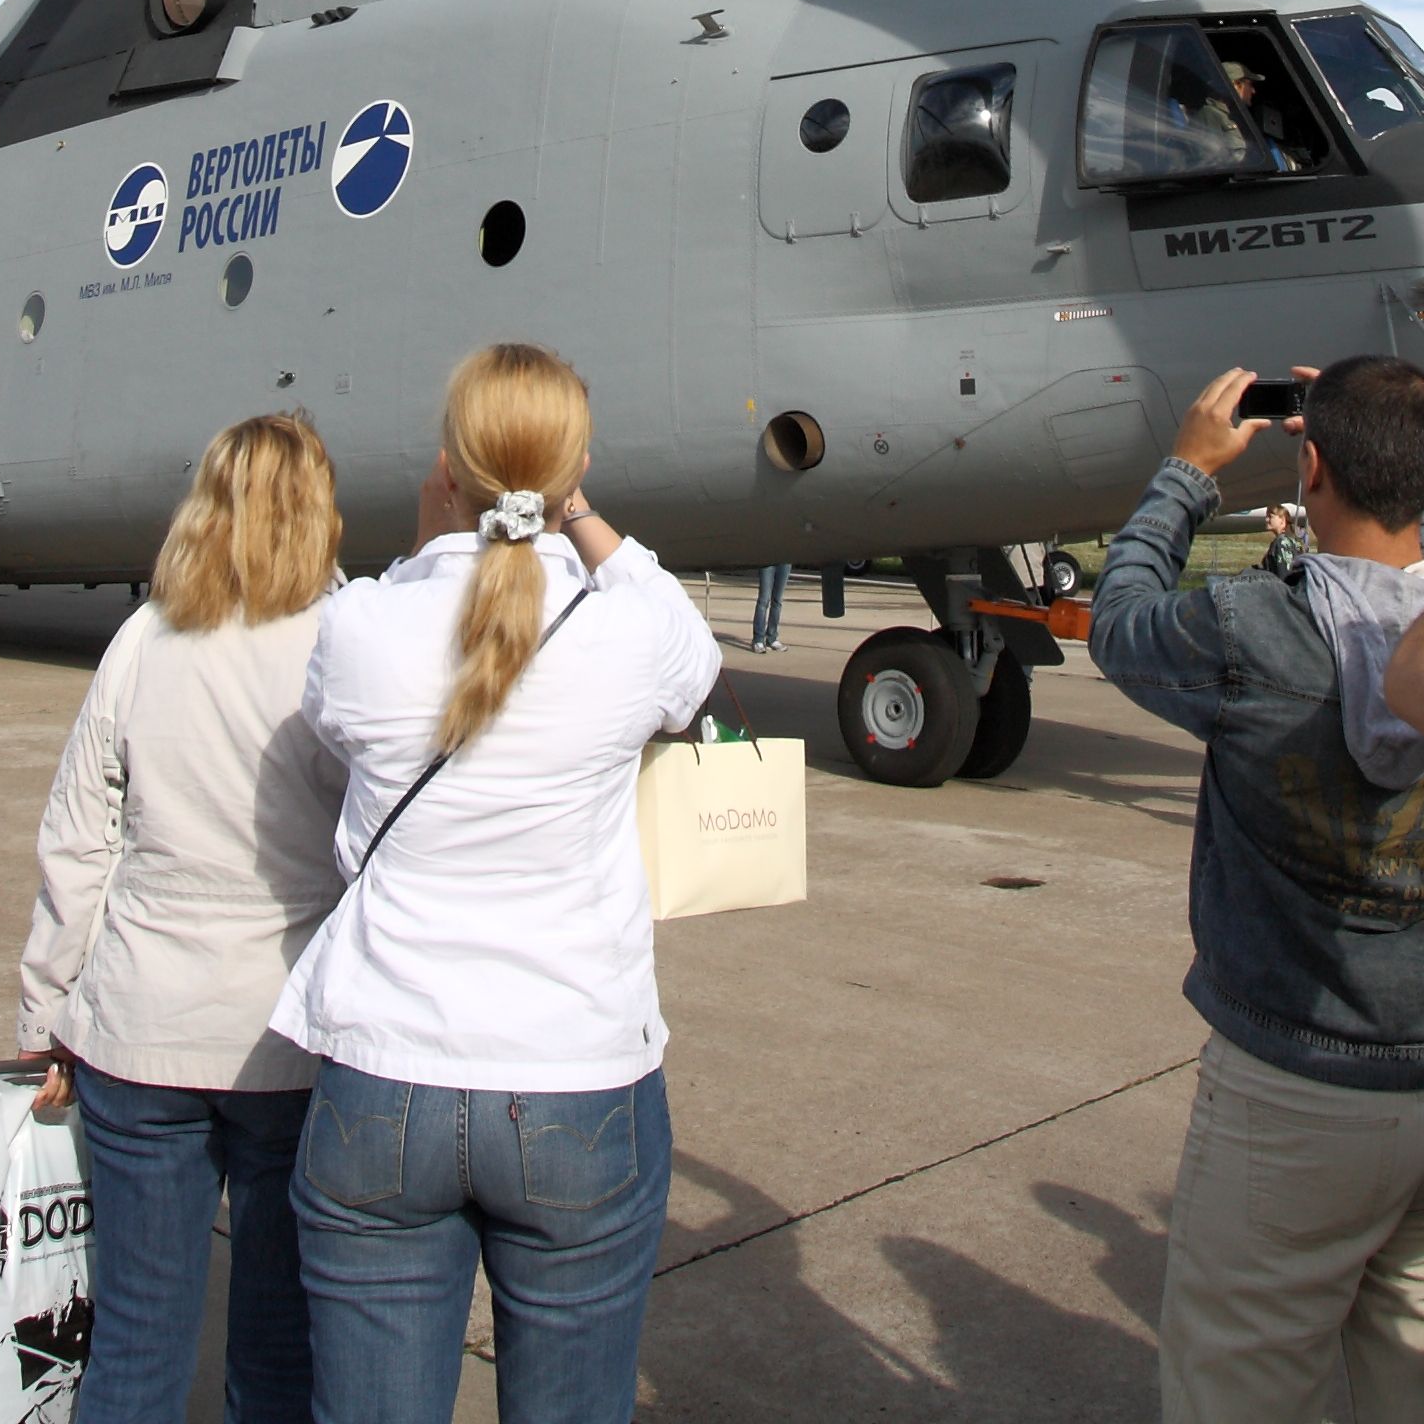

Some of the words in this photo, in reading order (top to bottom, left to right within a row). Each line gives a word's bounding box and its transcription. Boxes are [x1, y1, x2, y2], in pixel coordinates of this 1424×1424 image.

[186, 120, 327, 200] ВЕРТОЛЕТЫ
[108, 202, 165, 228] МИ
[178, 186, 282, 253] РОССИИ
[698, 808, 778, 833] MoDaMo
